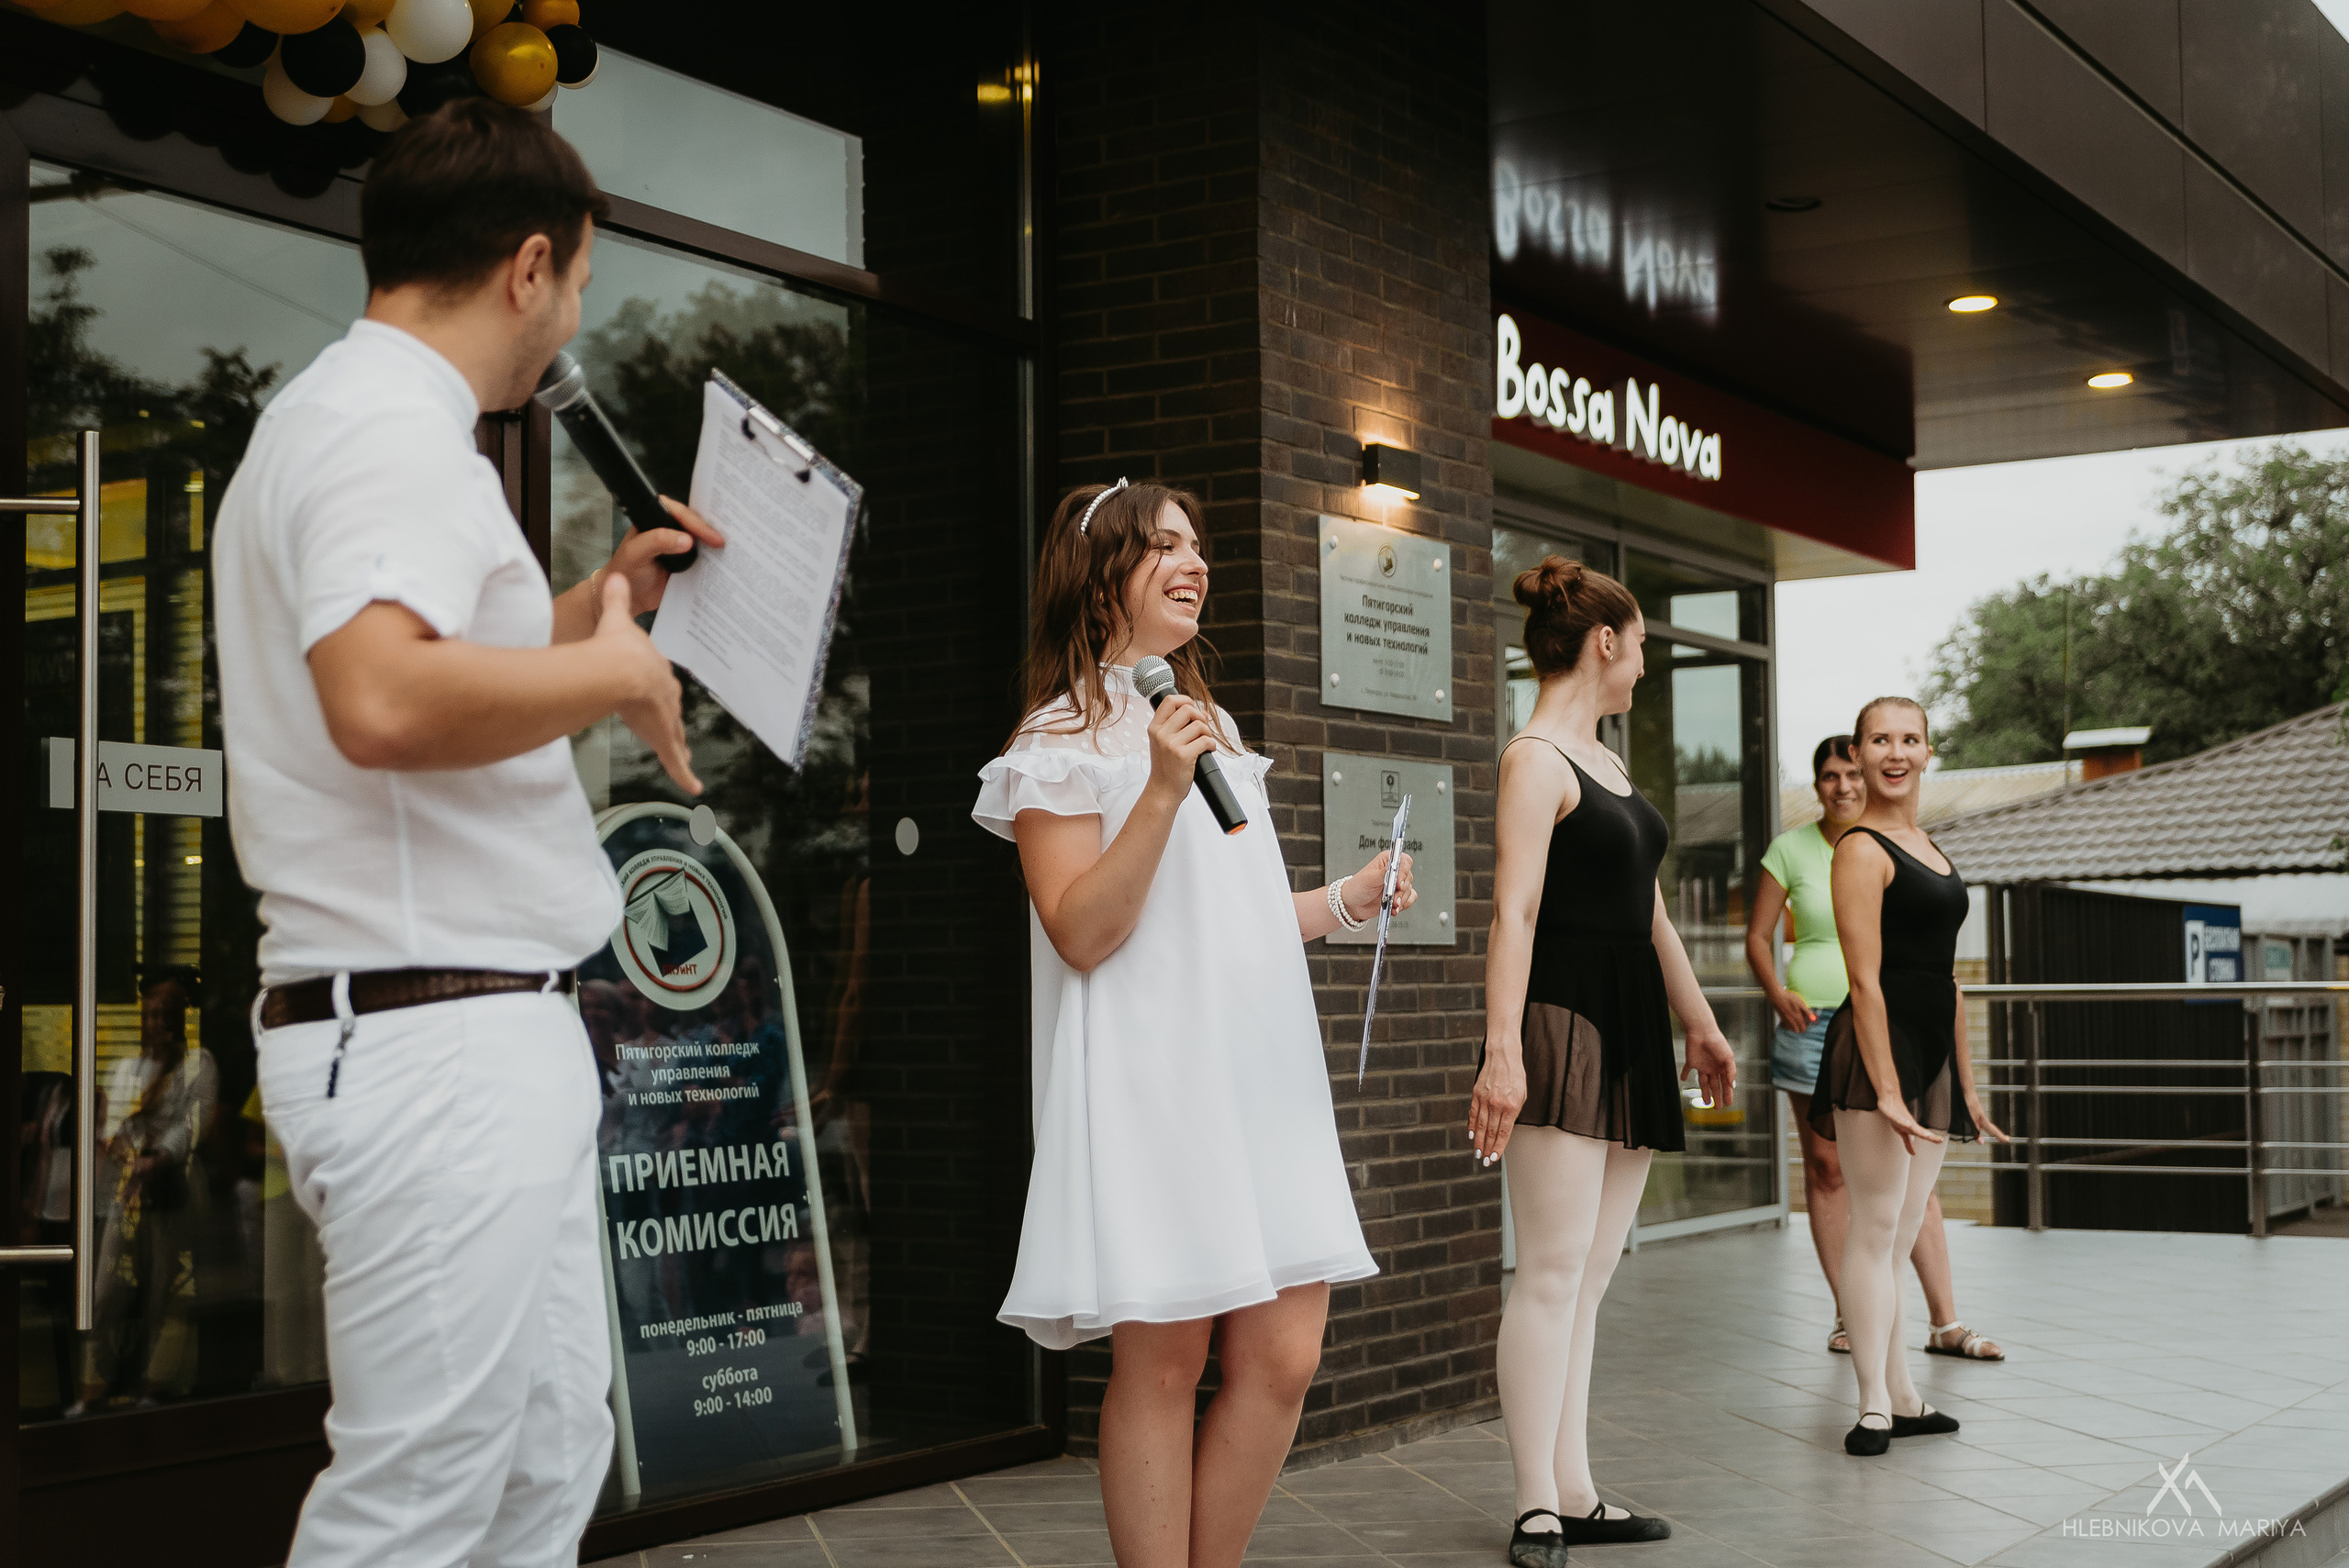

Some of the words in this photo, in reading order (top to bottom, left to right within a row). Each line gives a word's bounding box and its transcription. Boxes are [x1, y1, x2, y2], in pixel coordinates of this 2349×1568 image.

[1497, 313, 1616, 445] Bossa
[1626, 376, 1722, 481] Nova
[1363, 595, 1414, 616] Пятигорский
[1344, 612, 1381, 628] колледж
[1383, 619, 1431, 638] управления
[1346, 631, 1352, 642] и
[1354, 633, 1380, 647] новых
[1383, 637, 1428, 655] технологий
[124, 762, 203, 793] СЕБЯ
[1359, 835, 1375, 850] Дом
[615, 1040, 703, 1062] Пятигорский
[705, 1042, 760, 1057] колледж
[651, 1065, 730, 1085] управления
[628, 1093, 638, 1106] и
[640, 1090, 683, 1106] новых
[685, 1082, 760, 1103] технологий
[608, 1141, 790, 1194] ПРИЕМНАЯ
[617, 1203, 798, 1260] КОМИССИЯ
[640, 1311, 736, 1339] понедельник
[745, 1301, 804, 1322] пятница
[686, 1336, 716, 1357] 9:00
[727, 1329, 766, 1350] 17:00
[702, 1366, 758, 1393] суббота
[694, 1396, 723, 1417] 9:00
[734, 1386, 773, 1408] 14:00
